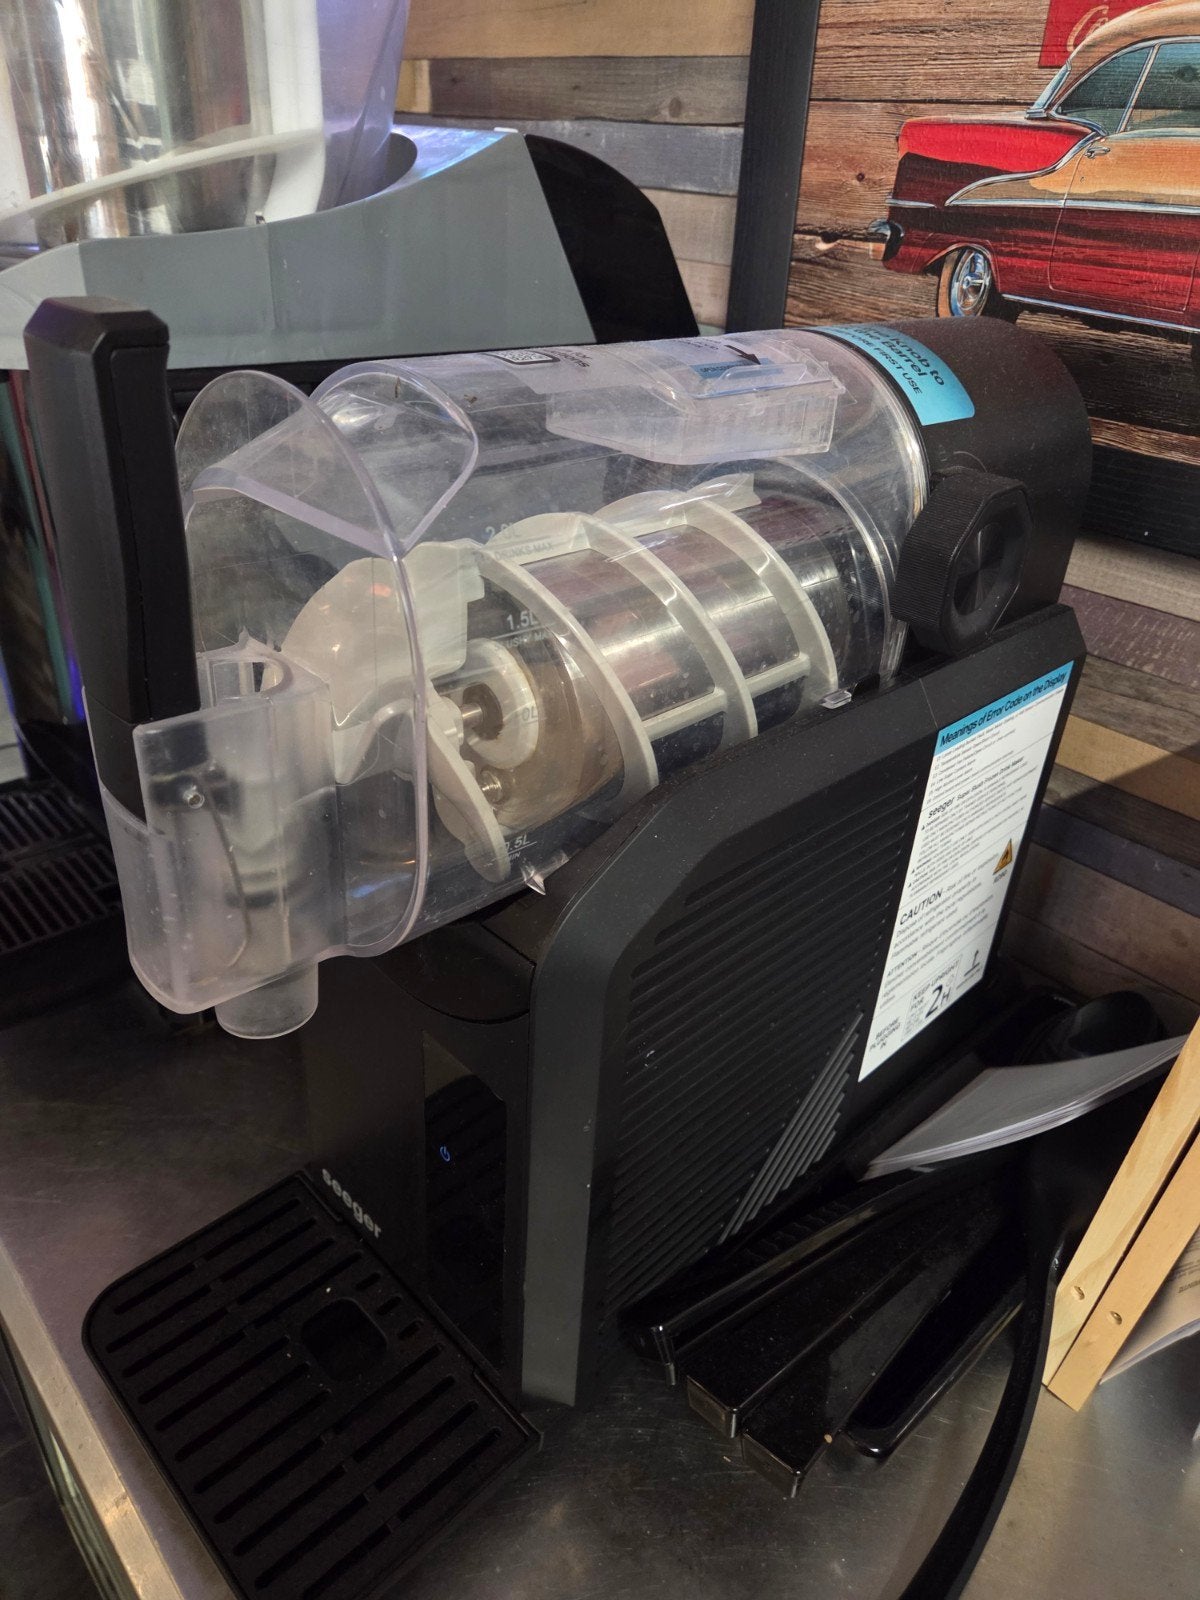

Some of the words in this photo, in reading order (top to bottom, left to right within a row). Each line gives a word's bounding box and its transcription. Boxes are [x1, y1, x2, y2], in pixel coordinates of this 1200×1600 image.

[874, 347, 904, 371] FIRST
[902, 373, 923, 394] USE
[881, 341, 928, 376] Barrel
[889, 338, 930, 367] Knob
[930, 370, 944, 386] to
[506, 610, 539, 631] 1.5L
[940, 721, 978, 747] Meanings
[978, 712, 987, 726] of
[986, 706, 1004, 721] Error
[1004, 696, 1022, 711] Code
[1023, 691, 1032, 701] on
[1032, 685, 1043, 696] the
[1043, 673, 1067, 690] Display
[928, 797, 954, 818] seeger
[900, 889, 943, 926] CAUTION
[888, 952, 917, 976] ATTENTION
[925, 984, 943, 1017] 2
[322, 1168, 382, 1238] seeger
